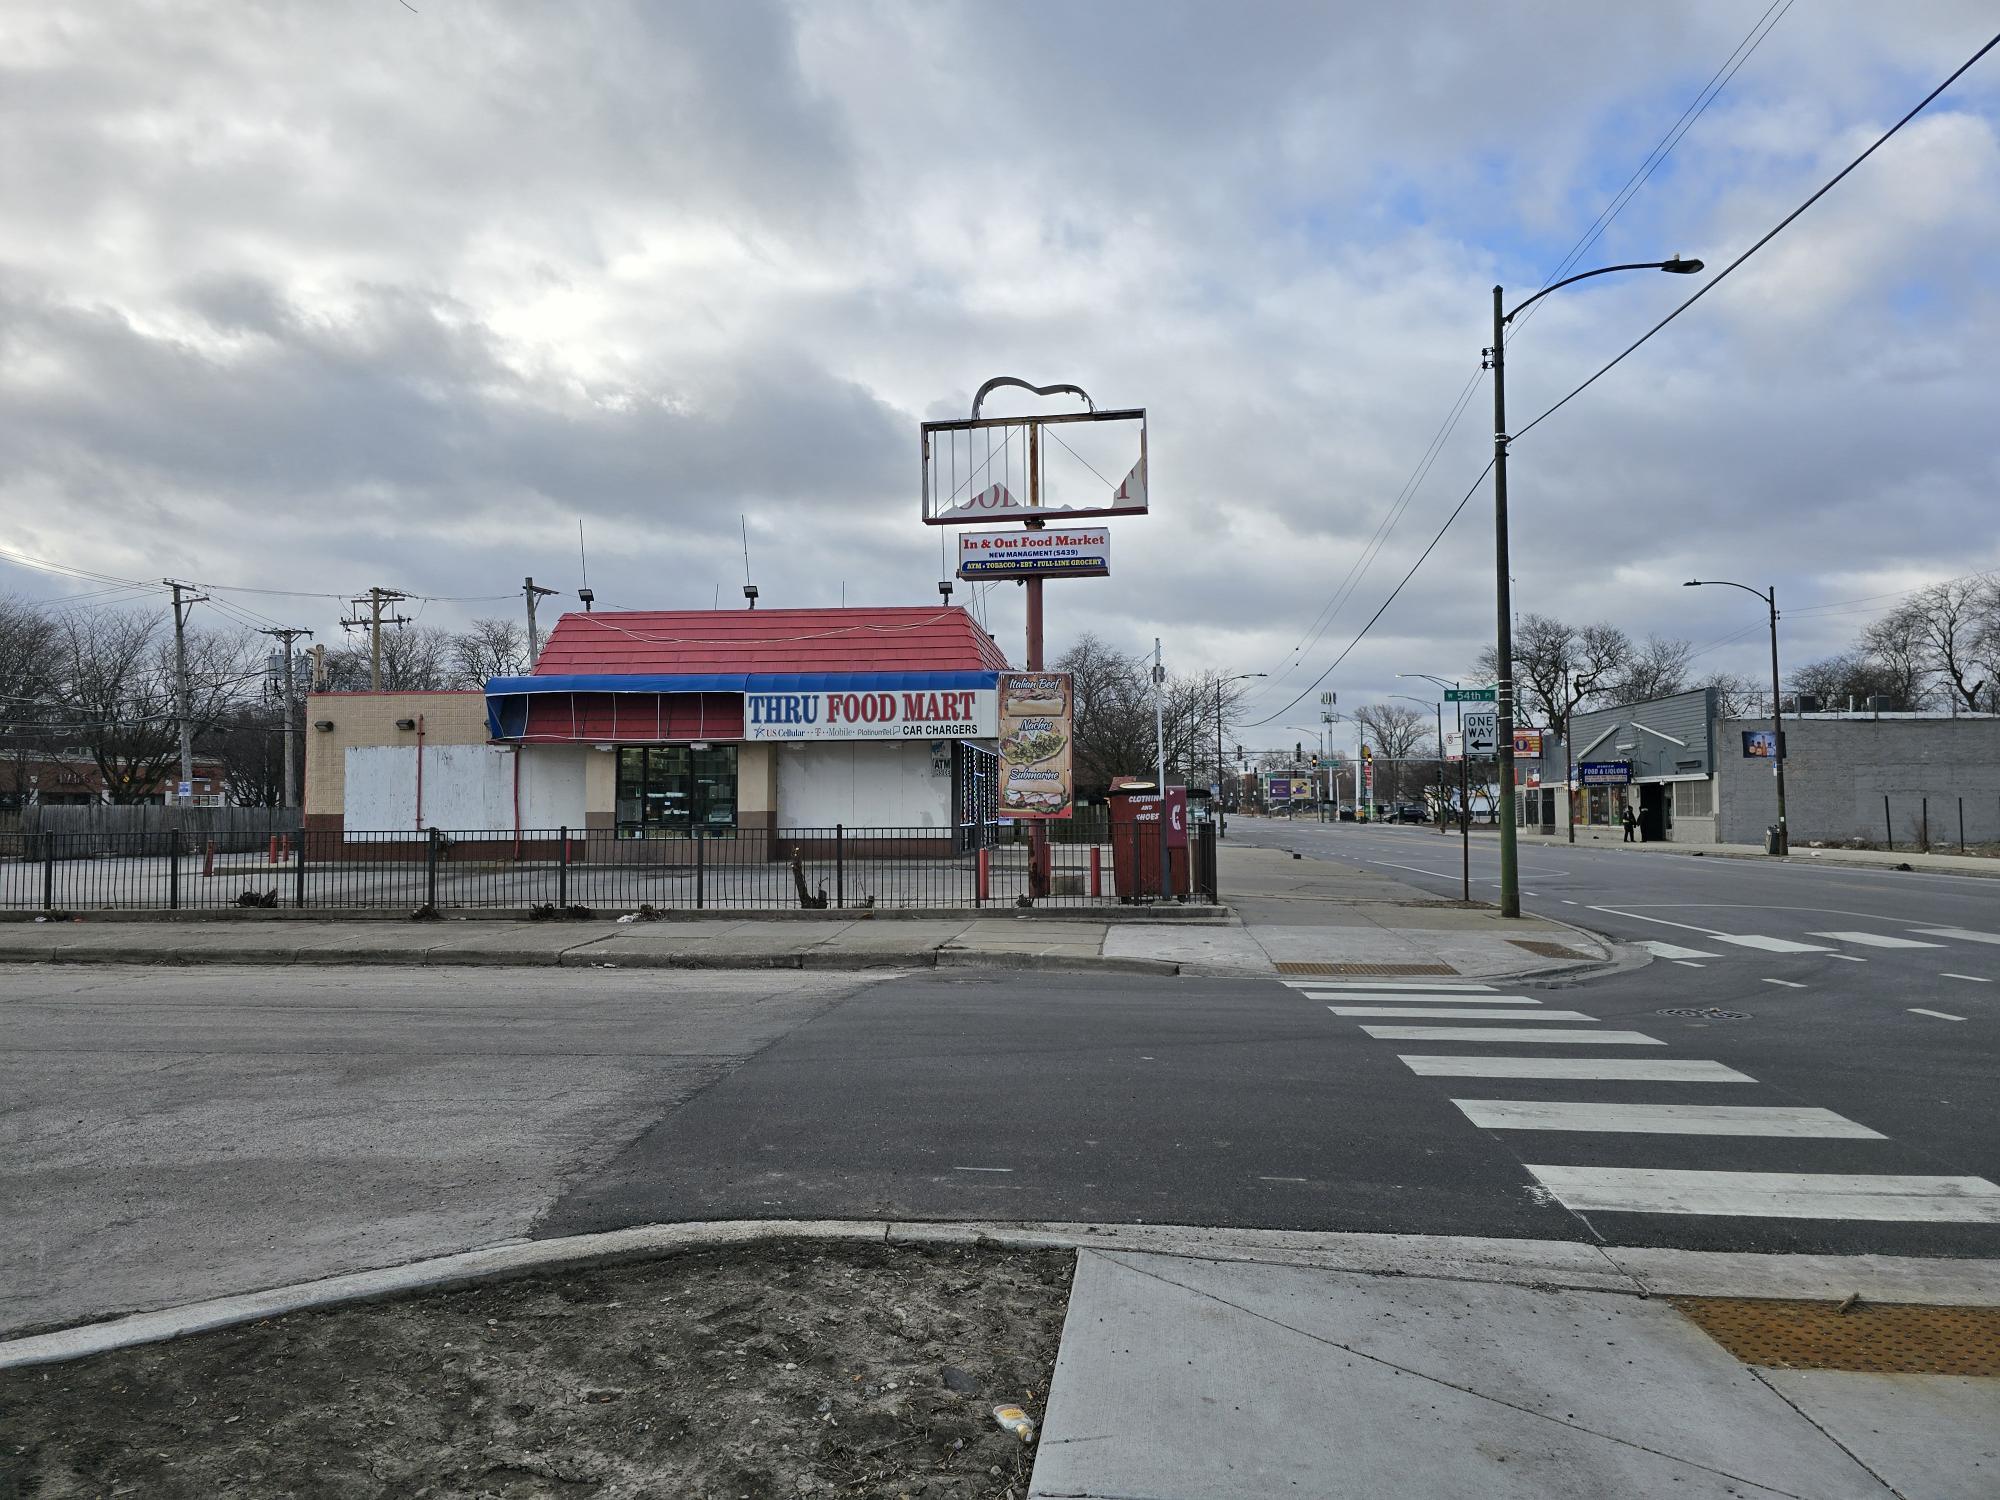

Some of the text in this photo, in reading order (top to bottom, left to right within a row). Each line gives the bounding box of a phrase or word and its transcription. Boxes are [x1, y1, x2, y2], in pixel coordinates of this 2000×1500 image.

[963, 534, 1105, 550] In & Out Food Market
[988, 551, 1006, 559] NEW
[1006, 549, 1053, 558] MANAGMENT
[985, 562, 1016, 570] TOBACCO
[1037, 559, 1071, 567] FULL-LINE
[1070, 558, 1102, 566] GROCERY
[1009, 678, 1061, 690] Italian Beef
[1457, 691, 1481, 701] 54th
[748, 692, 976, 725] THRU FOOD MART
[1020, 719, 1053, 732] Nachos
[1468, 716, 1494, 727] ONE
[778, 728, 806, 738] Cellular
[902, 725, 923, 736] CAR
[928, 724, 978, 735] CHARGERS
[1467, 728, 1494, 738] WAY
[1010, 768, 1059, 780] Submarine
[1136, 813, 1160, 821] SHOES
